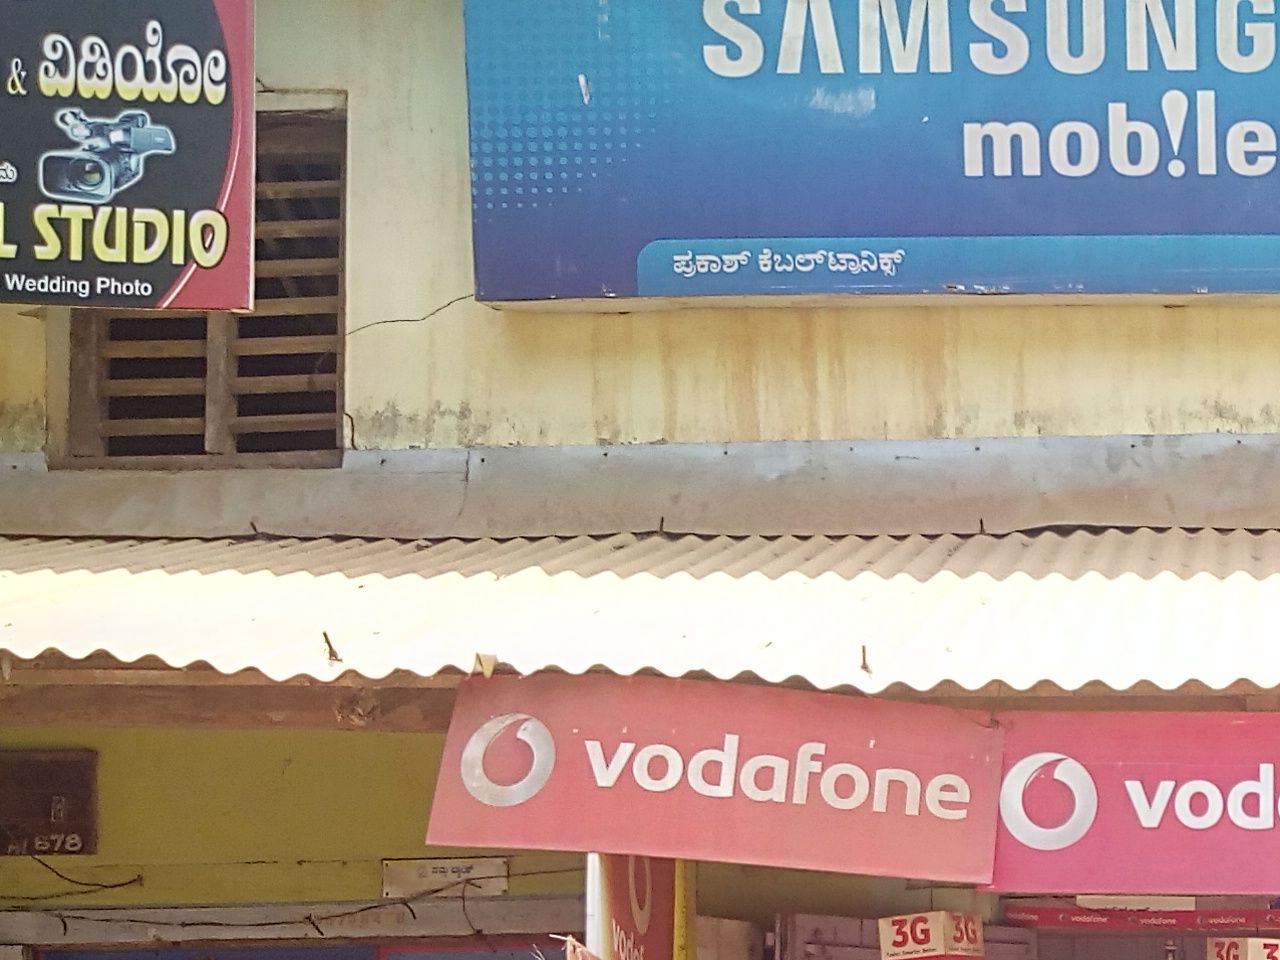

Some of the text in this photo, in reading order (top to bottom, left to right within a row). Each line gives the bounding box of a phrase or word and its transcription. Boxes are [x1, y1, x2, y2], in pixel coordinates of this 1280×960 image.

[7, 20, 227, 104] & ವಿಡಿಯೋ
[703, 0, 1276, 77] SAMSUNG
[33, 203, 228, 267] STUDIO
[5, 273, 152, 298] Wedding Photo
[673, 250, 751, 277] ಪ್ರಕಾಶ್
[585, 734, 970, 820] vodafone
[891, 915, 931, 948] 3G
[952, 913, 979, 945] 3G
